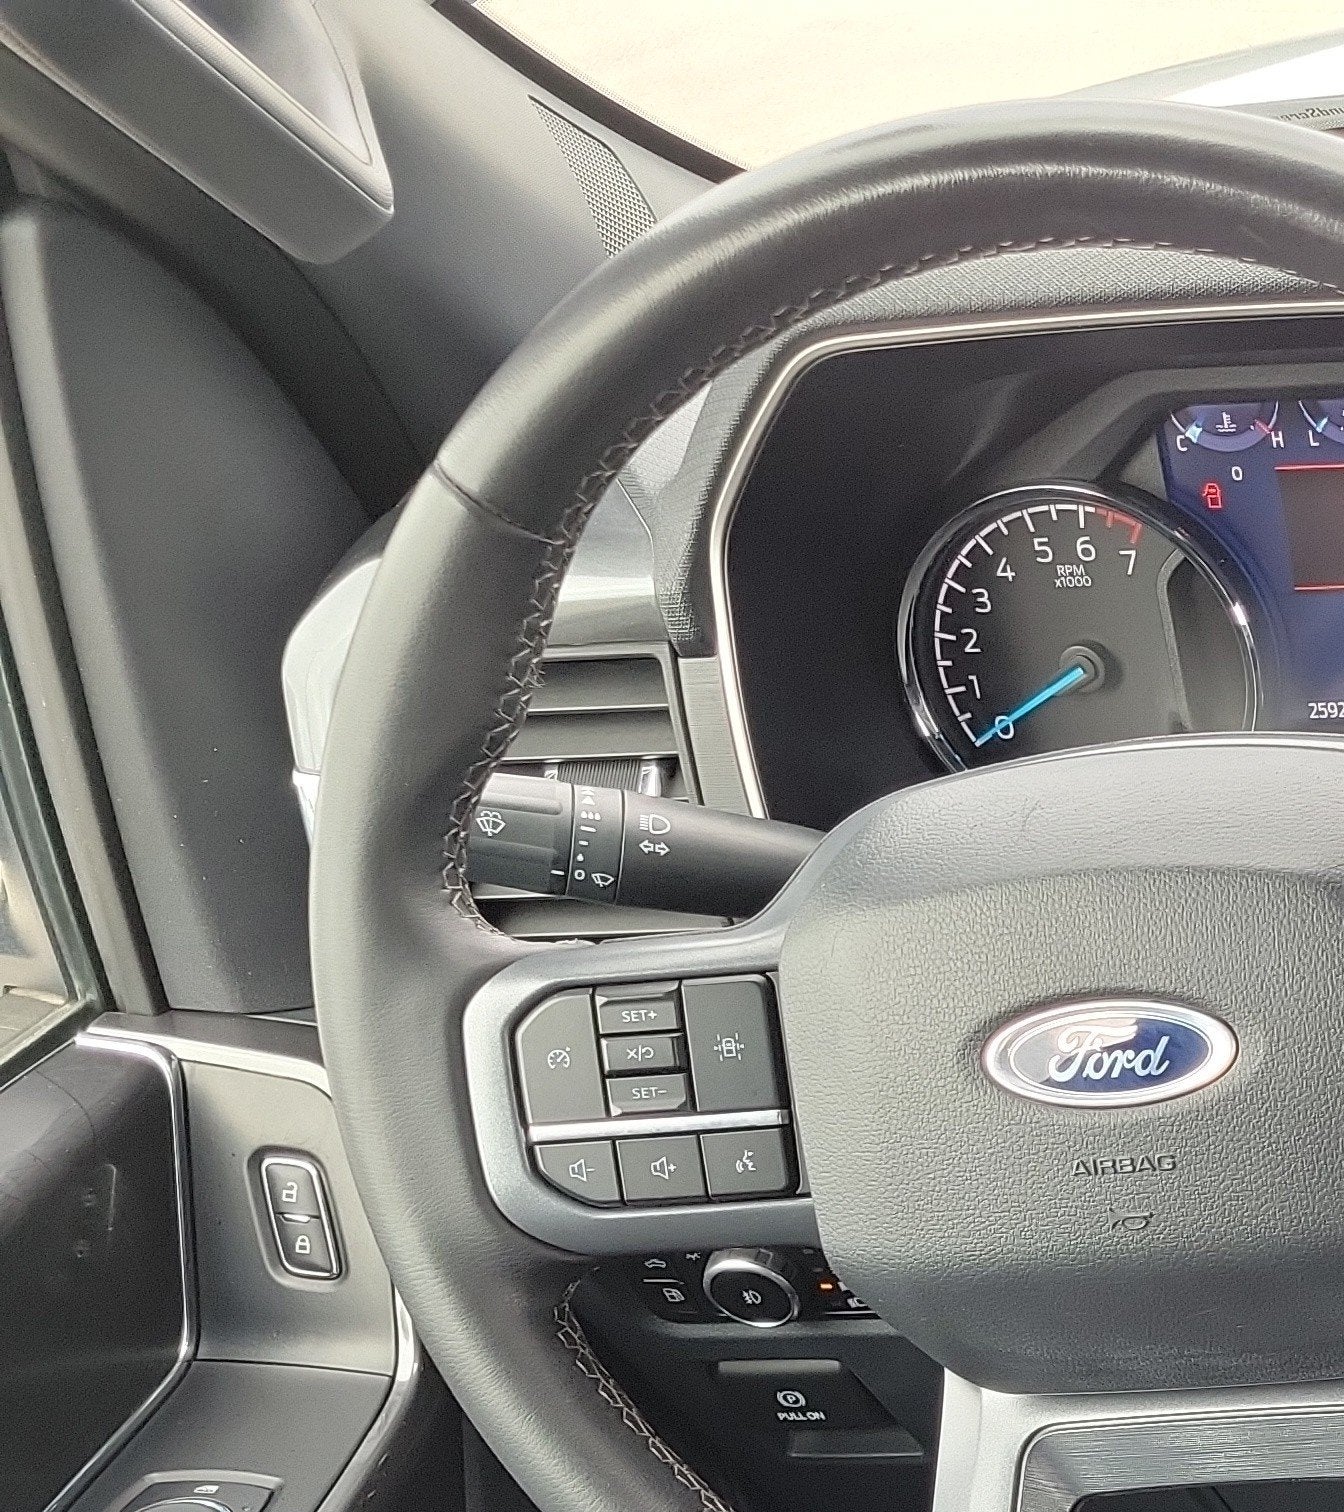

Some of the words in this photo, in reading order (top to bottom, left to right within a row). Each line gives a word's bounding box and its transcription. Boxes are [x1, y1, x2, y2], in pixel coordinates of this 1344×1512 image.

[1176, 435, 1187, 452] C
[1271, 431, 1284, 448] H
[1309, 430, 1320, 447] L
[1033, 537, 1054, 563] 5
[1075, 536, 1097, 562] 6
[996, 557, 1016, 582] 4
[1055, 564, 1086, 576] RPM
[1118, 549, 1137, 576] 7
[1053, 575, 1093, 588] x1000
[971, 588, 992, 613] 3
[961, 628, 982, 653] 2
[967, 674, 982, 700] 1
[994, 715, 1015, 740] 0
[621, 1009, 658, 1023] SET+
[1048, 1023, 1171, 1083] Ford
[1071, 1153, 1178, 1178] AIRBAG
[806, 1411, 826, 1421] ON
